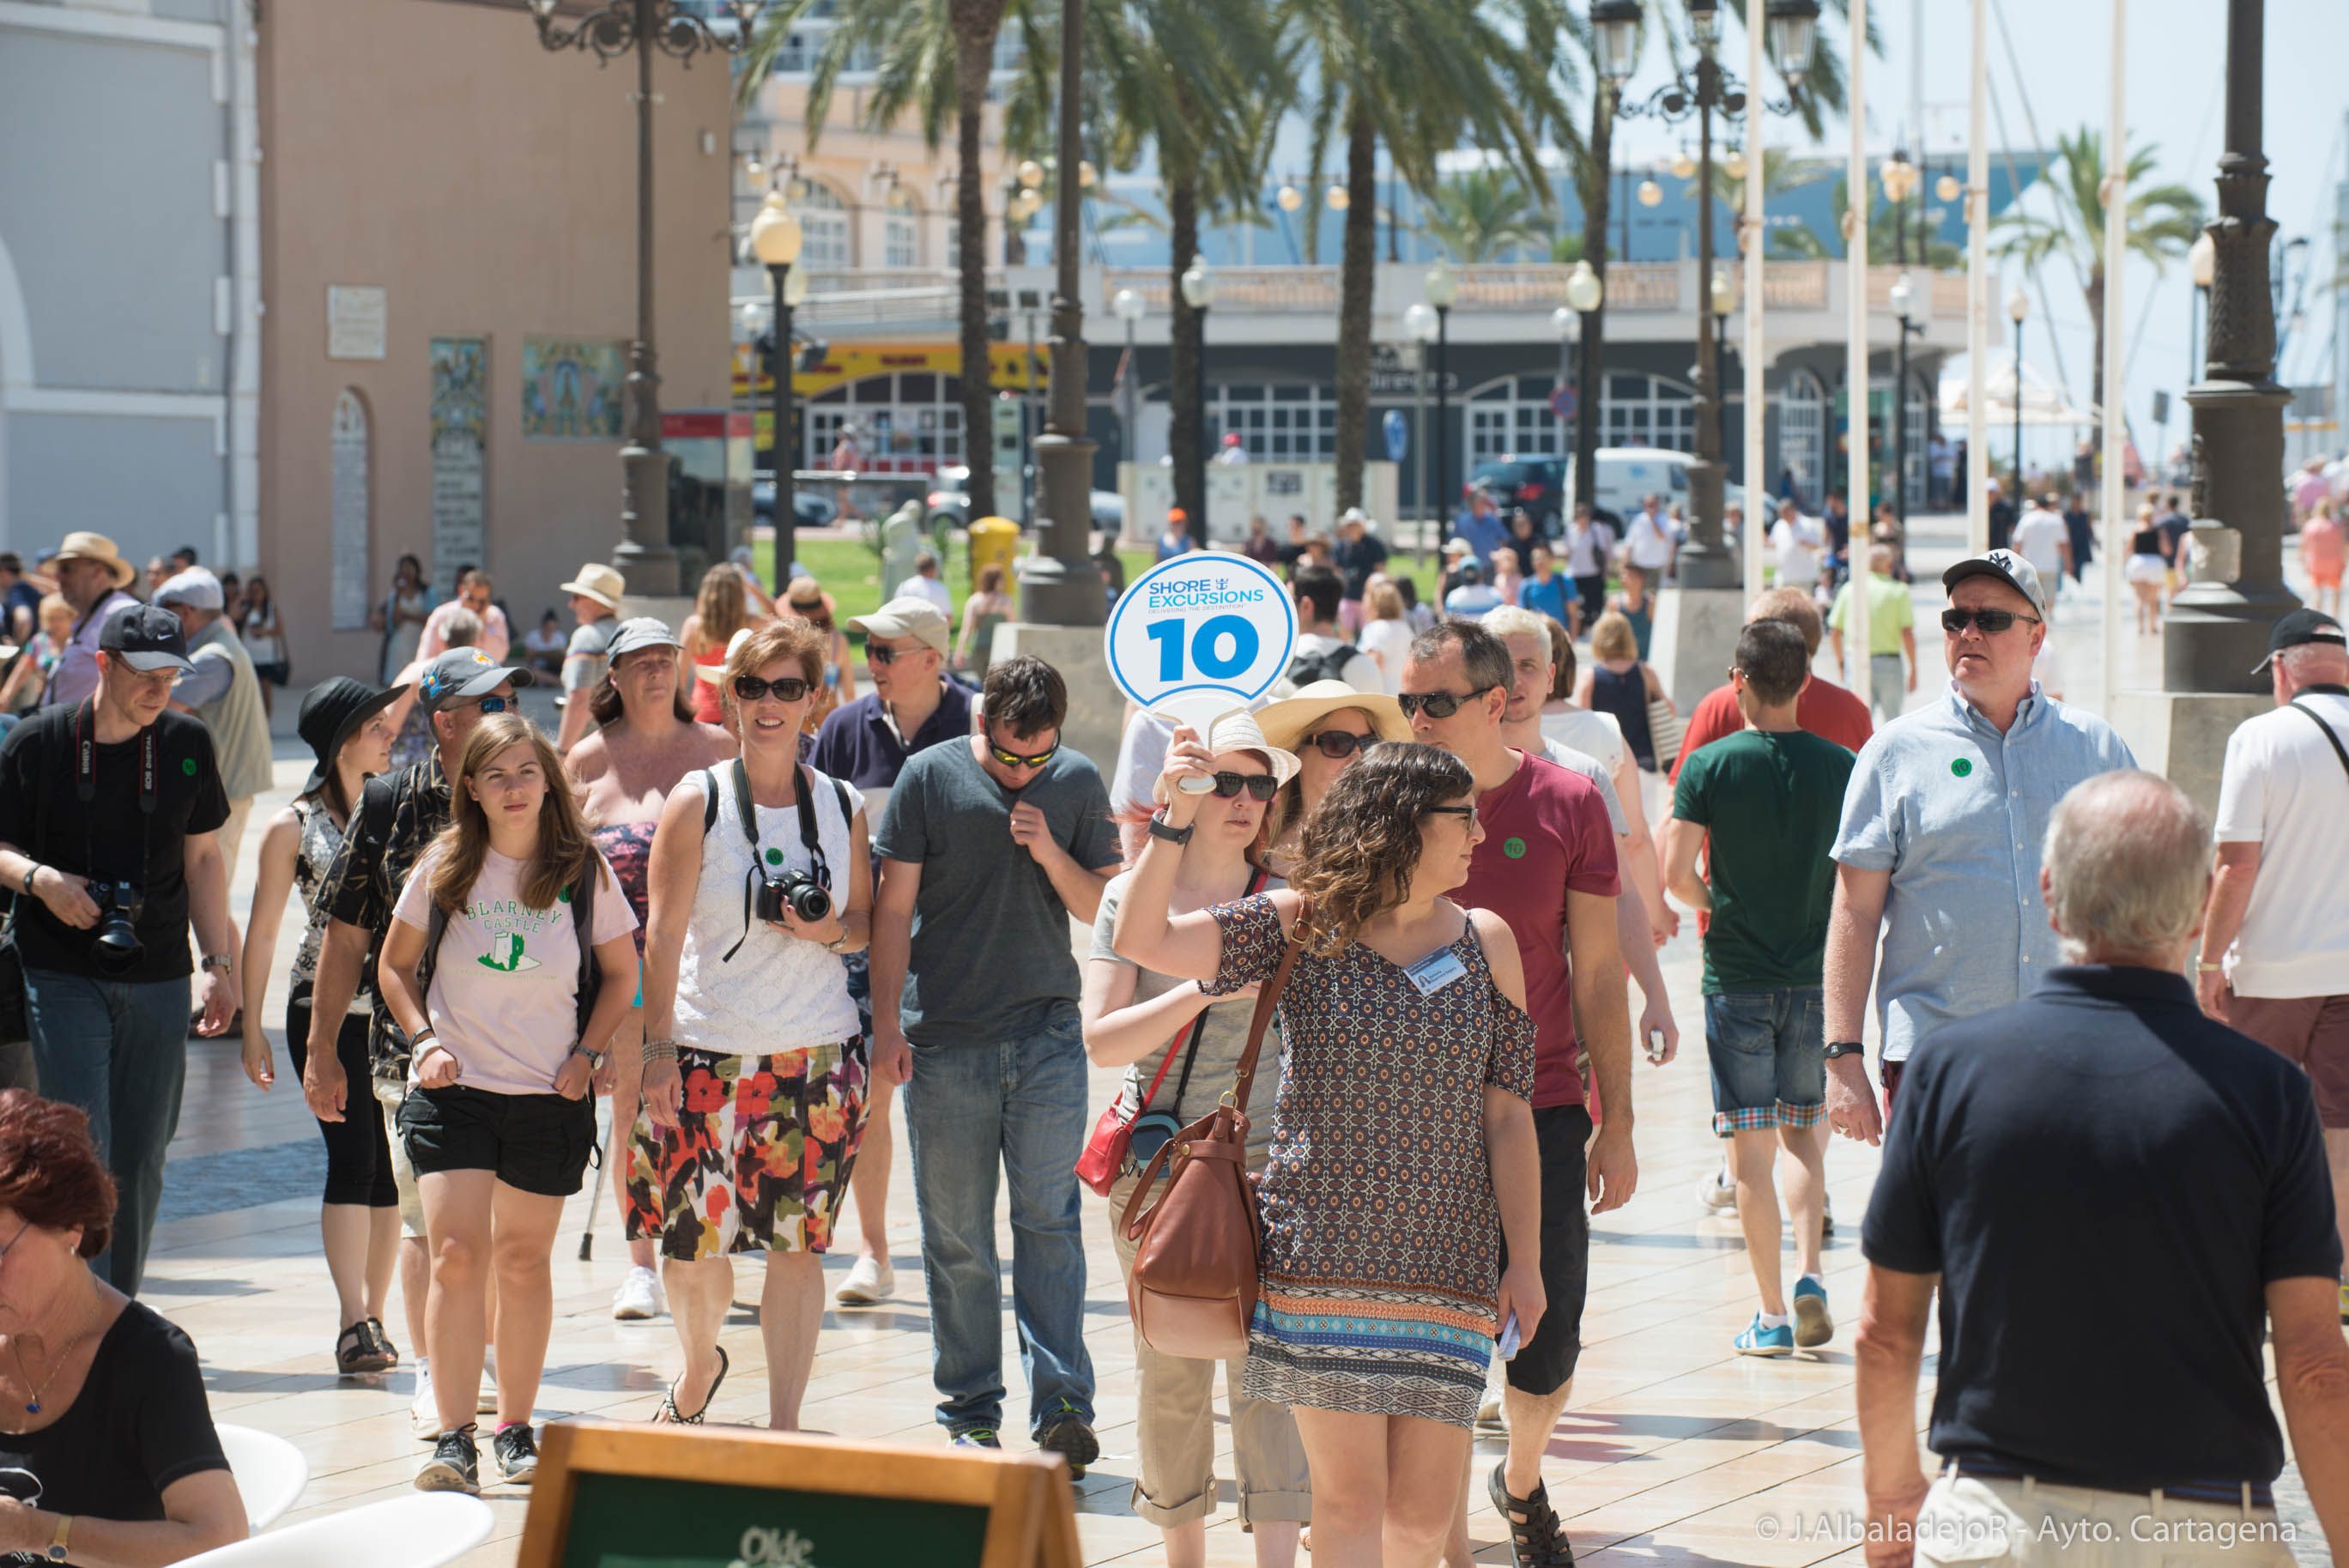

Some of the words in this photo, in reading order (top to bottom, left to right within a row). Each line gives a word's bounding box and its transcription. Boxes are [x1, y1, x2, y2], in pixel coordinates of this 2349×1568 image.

[1149, 578, 1211, 595] SHORE
[1149, 589, 1264, 608] EXCURSIONS
[1147, 614, 1259, 682] 10
[82, 740, 92, 774] Canon
[1954, 760, 1969, 774] 10
[1505, 842, 1523, 855] 10
[466, 899, 563, 924] BLARNEY
[483, 917, 542, 934] CASTLE
[740, 1526, 814, 1566] Olde
